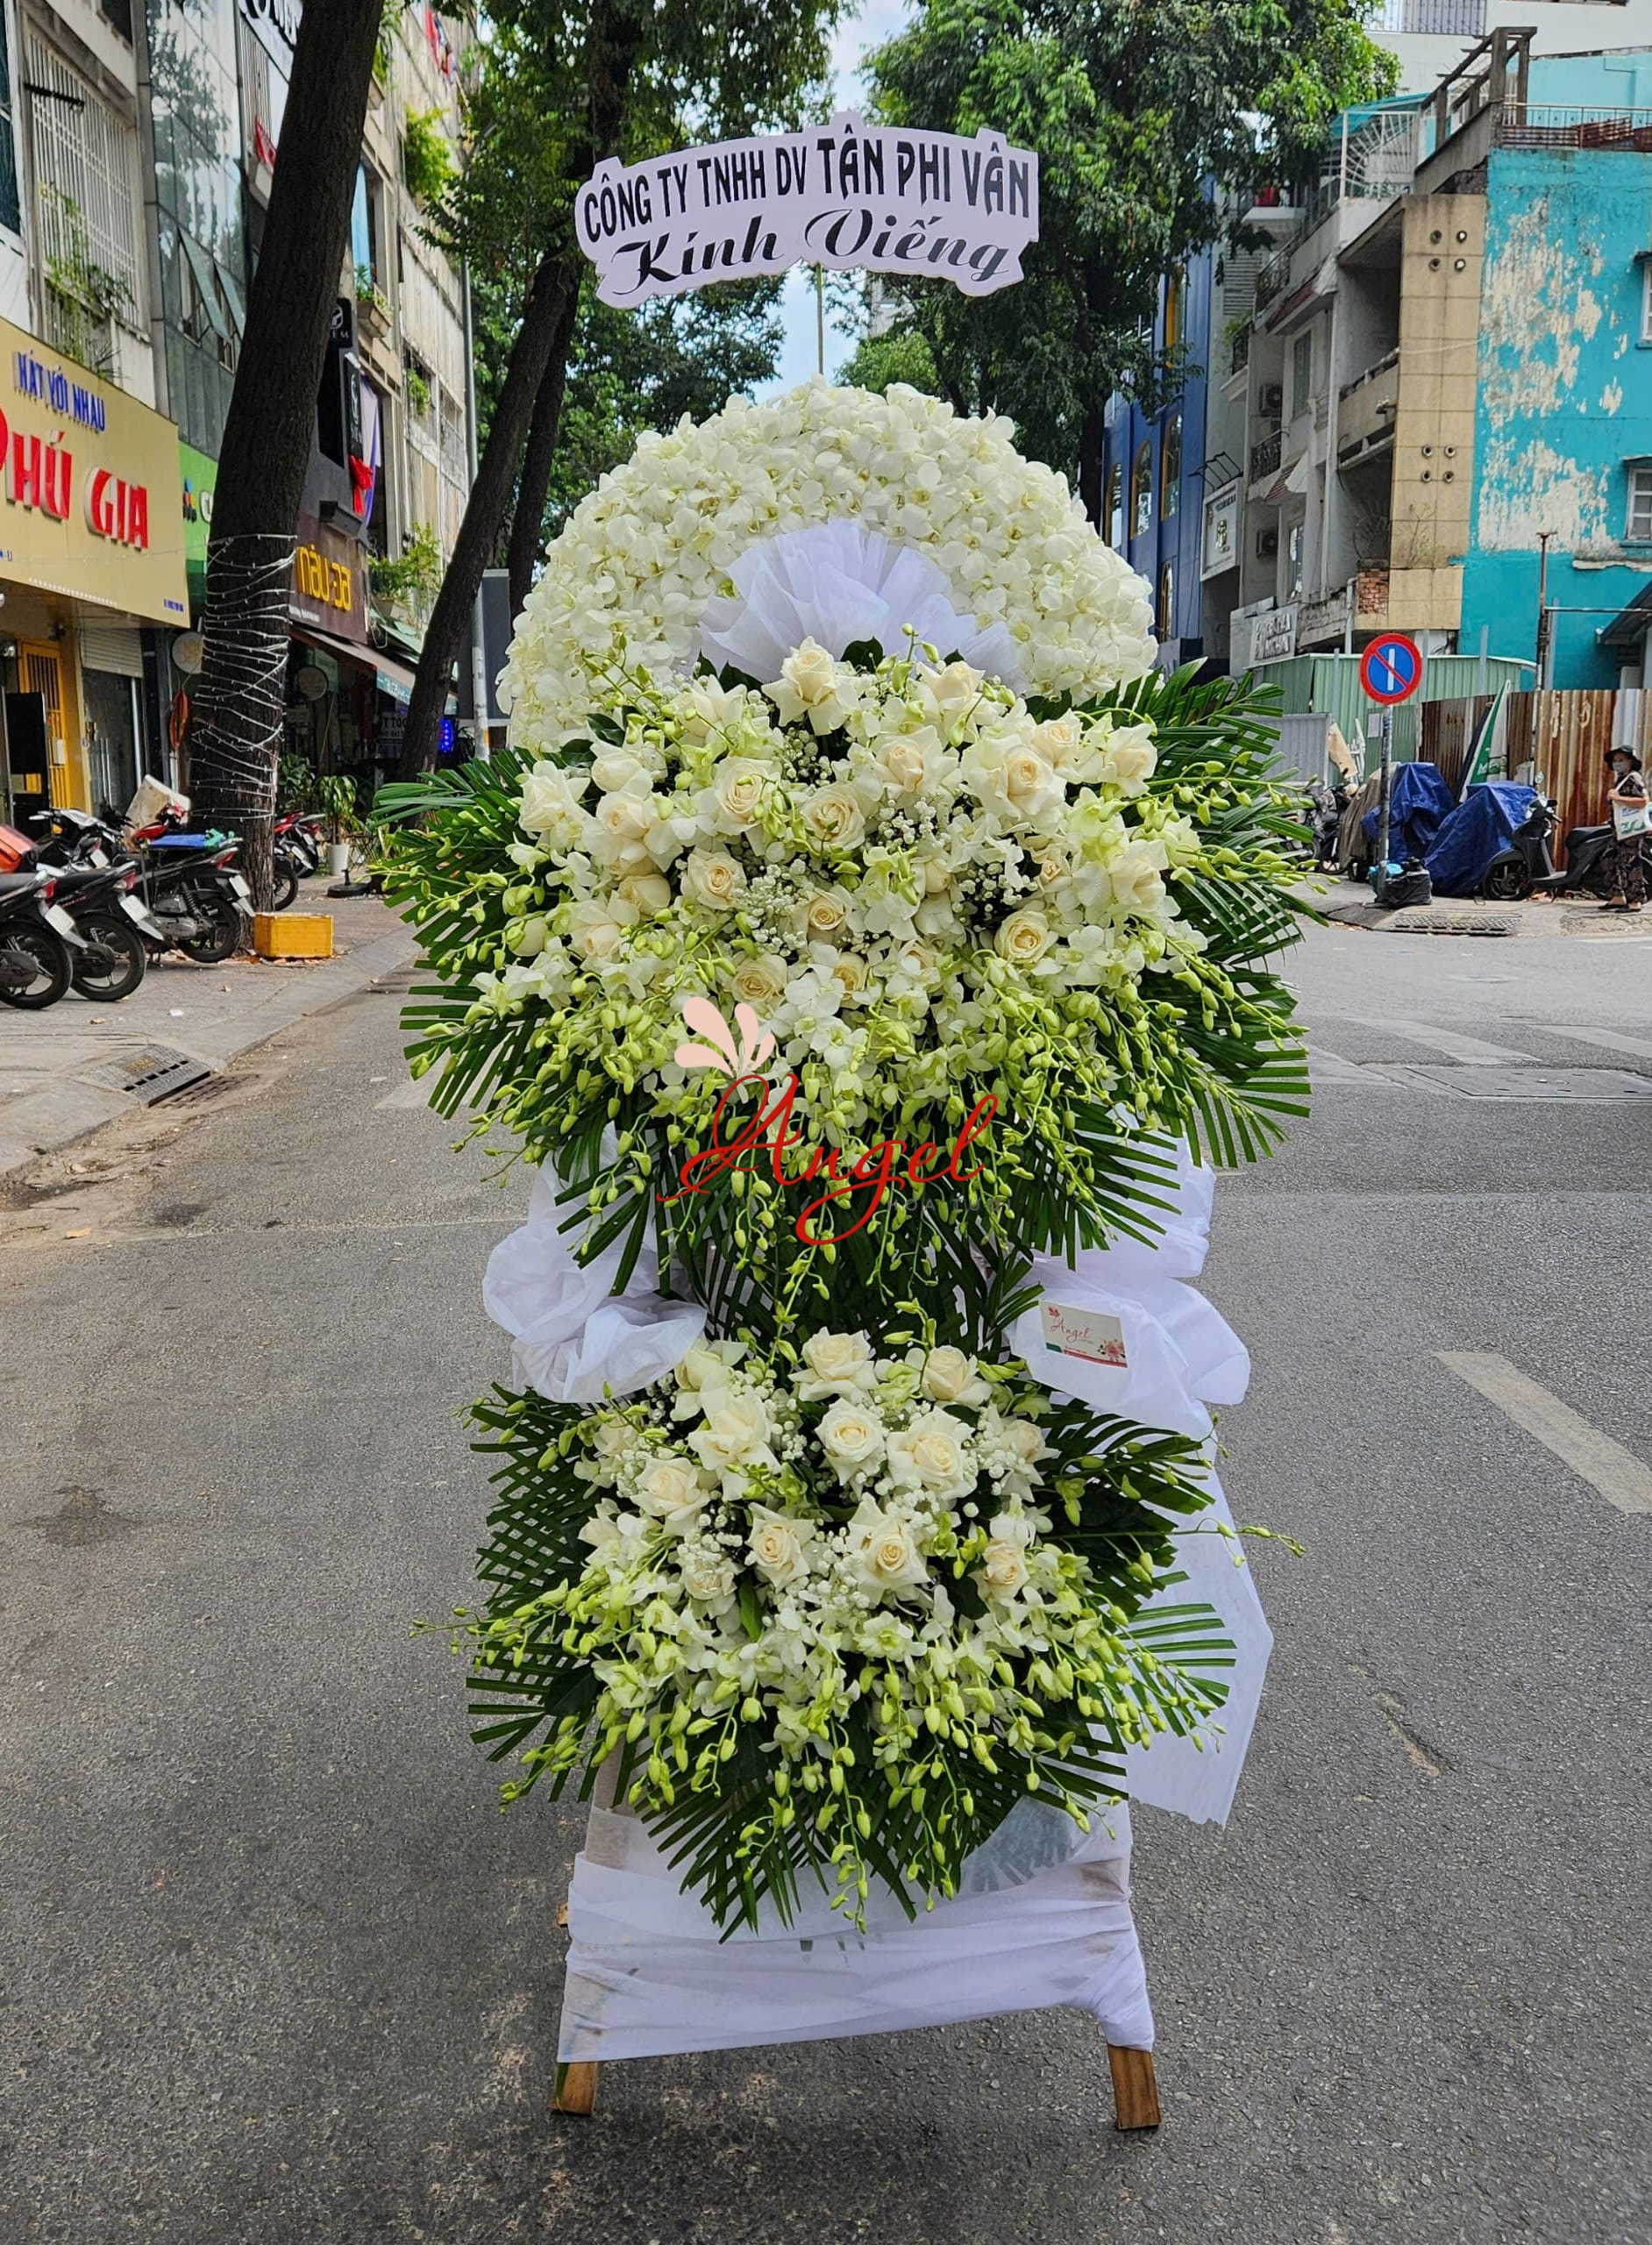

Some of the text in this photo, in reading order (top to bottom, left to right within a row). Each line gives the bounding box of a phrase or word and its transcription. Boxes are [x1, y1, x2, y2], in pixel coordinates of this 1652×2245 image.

[584, 123, 1029, 243] CÔNG TY TNHH DV TÂN PHI VÂN
[611, 209, 1009, 296] Kính Viếng
[17, 350, 105, 432] HÁT VỚI NHAU
[87, 467, 148, 549] GIA
[1050, 1317, 1091, 1343] Angel
